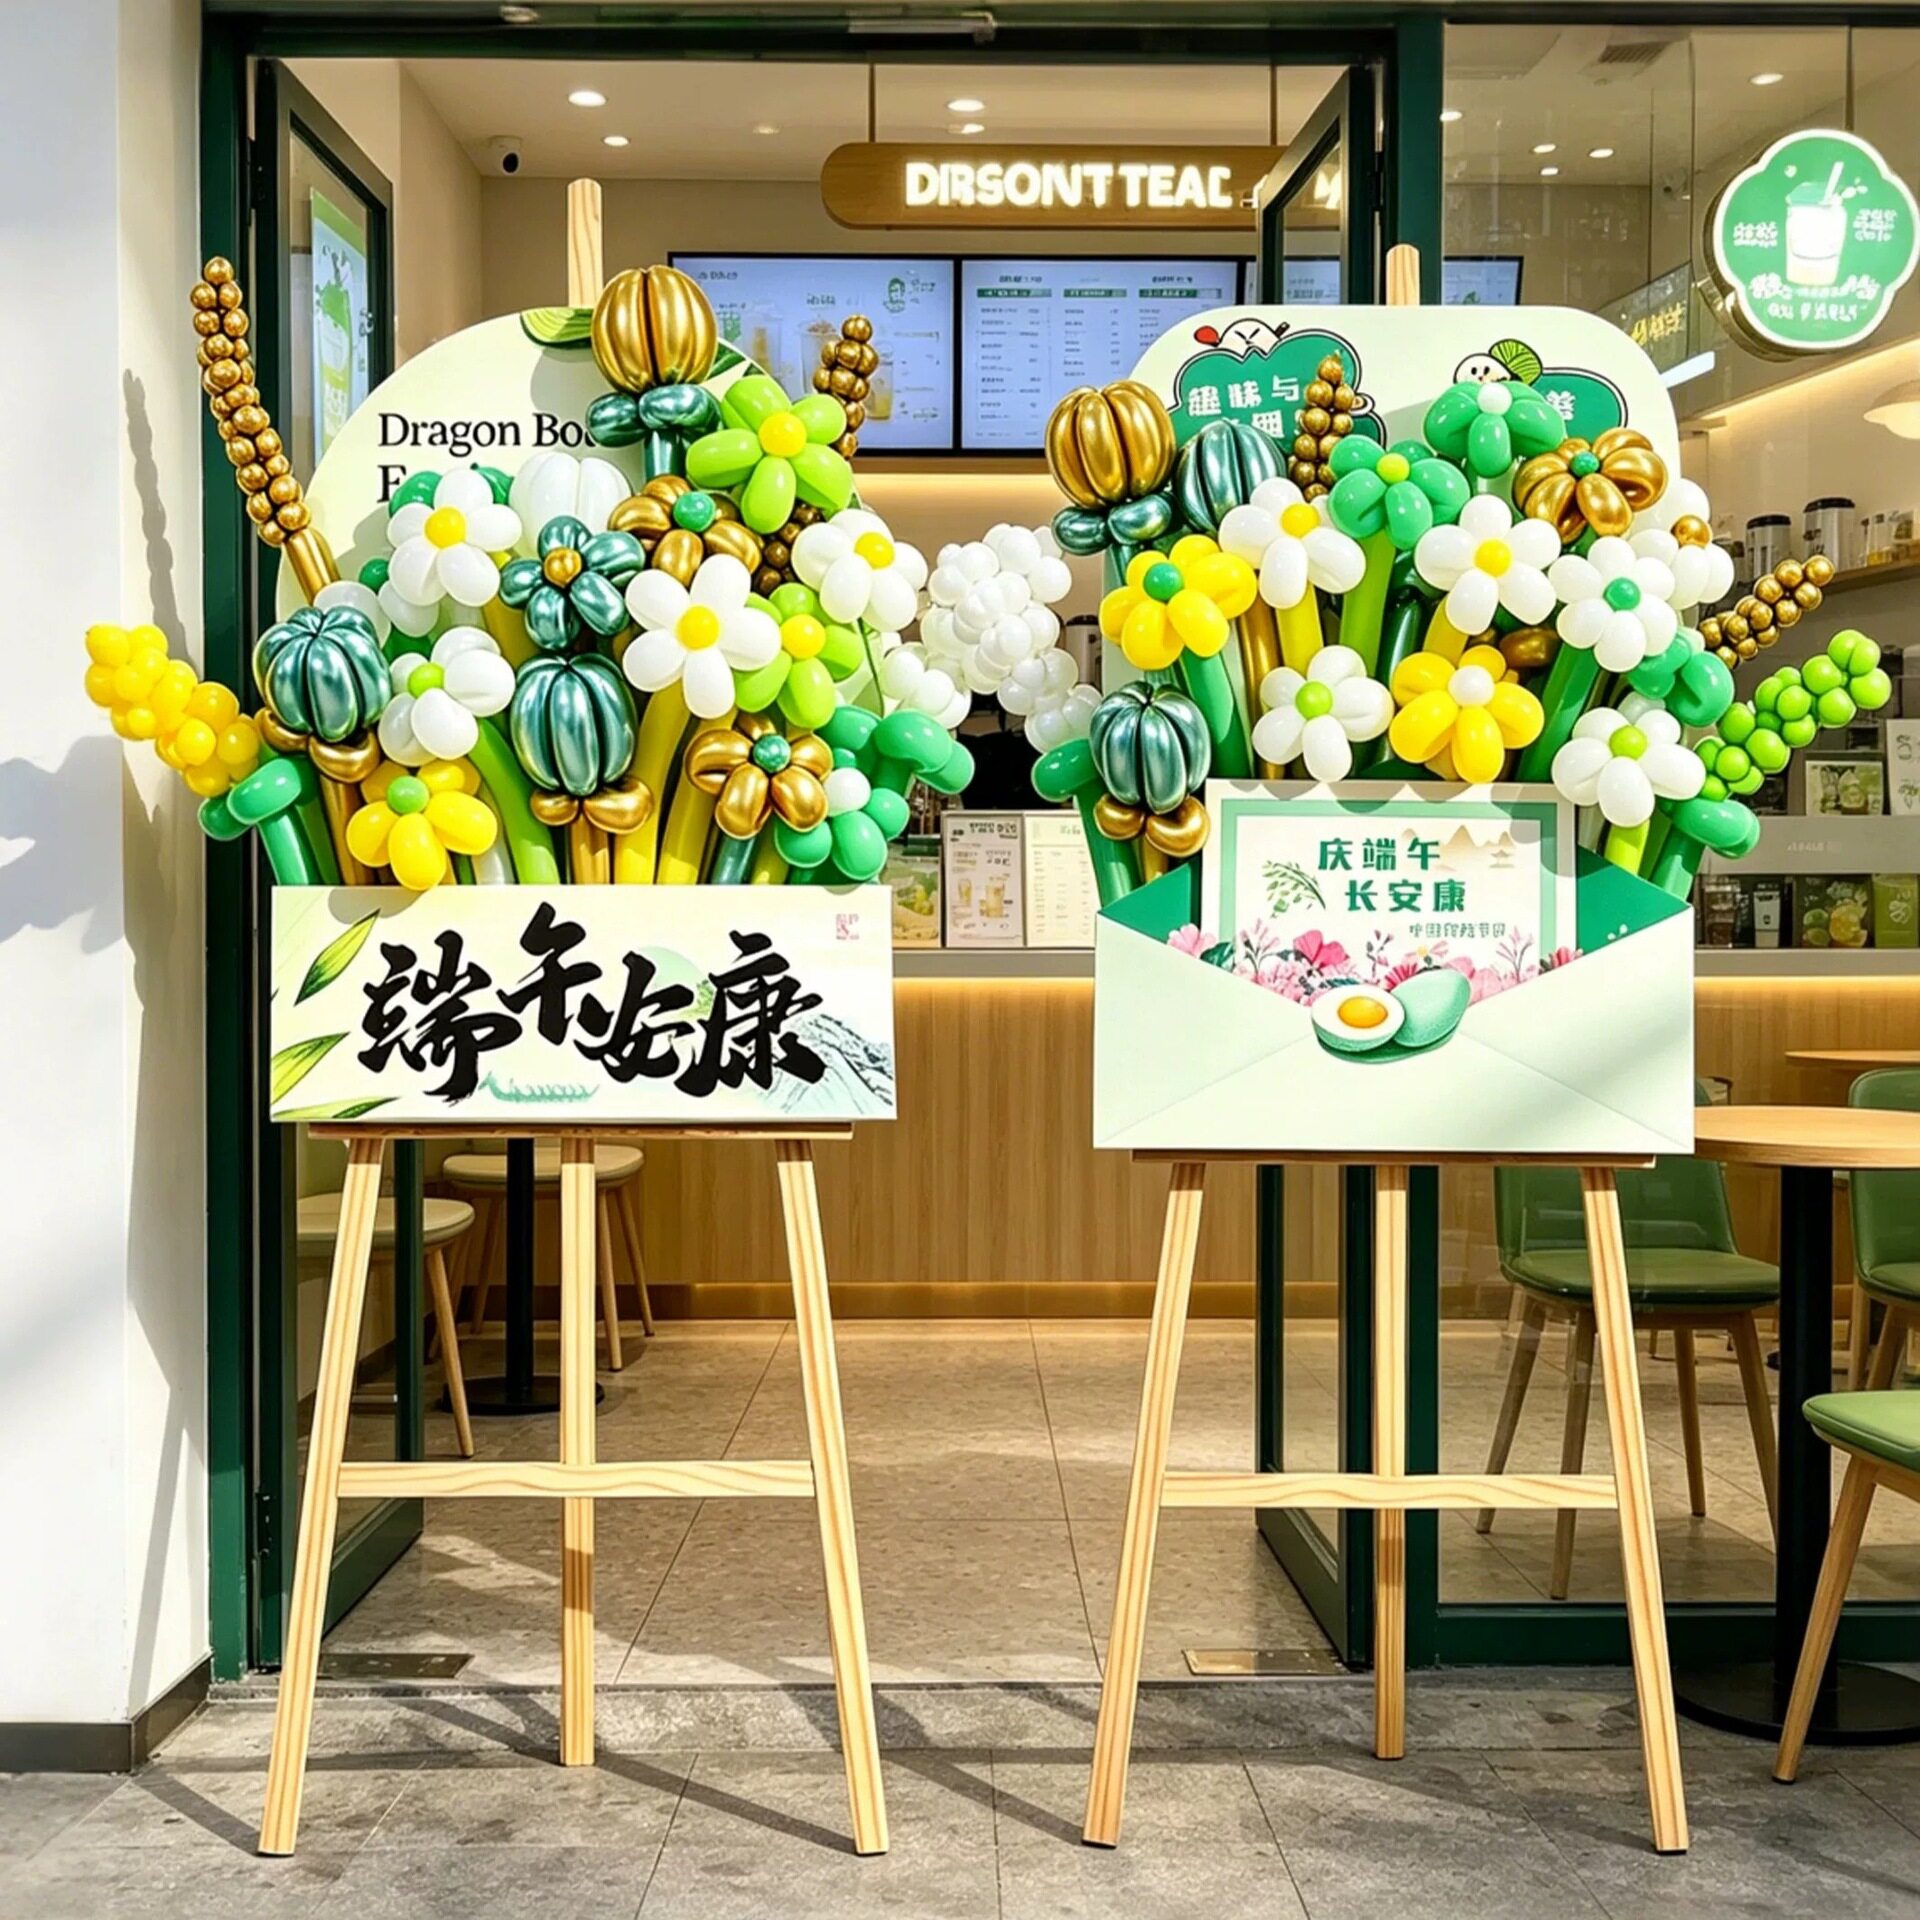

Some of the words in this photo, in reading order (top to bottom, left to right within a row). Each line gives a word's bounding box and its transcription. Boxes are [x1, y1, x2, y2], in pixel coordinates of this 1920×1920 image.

[377, 413, 521, 458] Dragon
[1317, 836, 1441, 872] 庆端午
[1344, 878, 1467, 913] 长安康
[356, 901, 826, 1107] 端午安康
